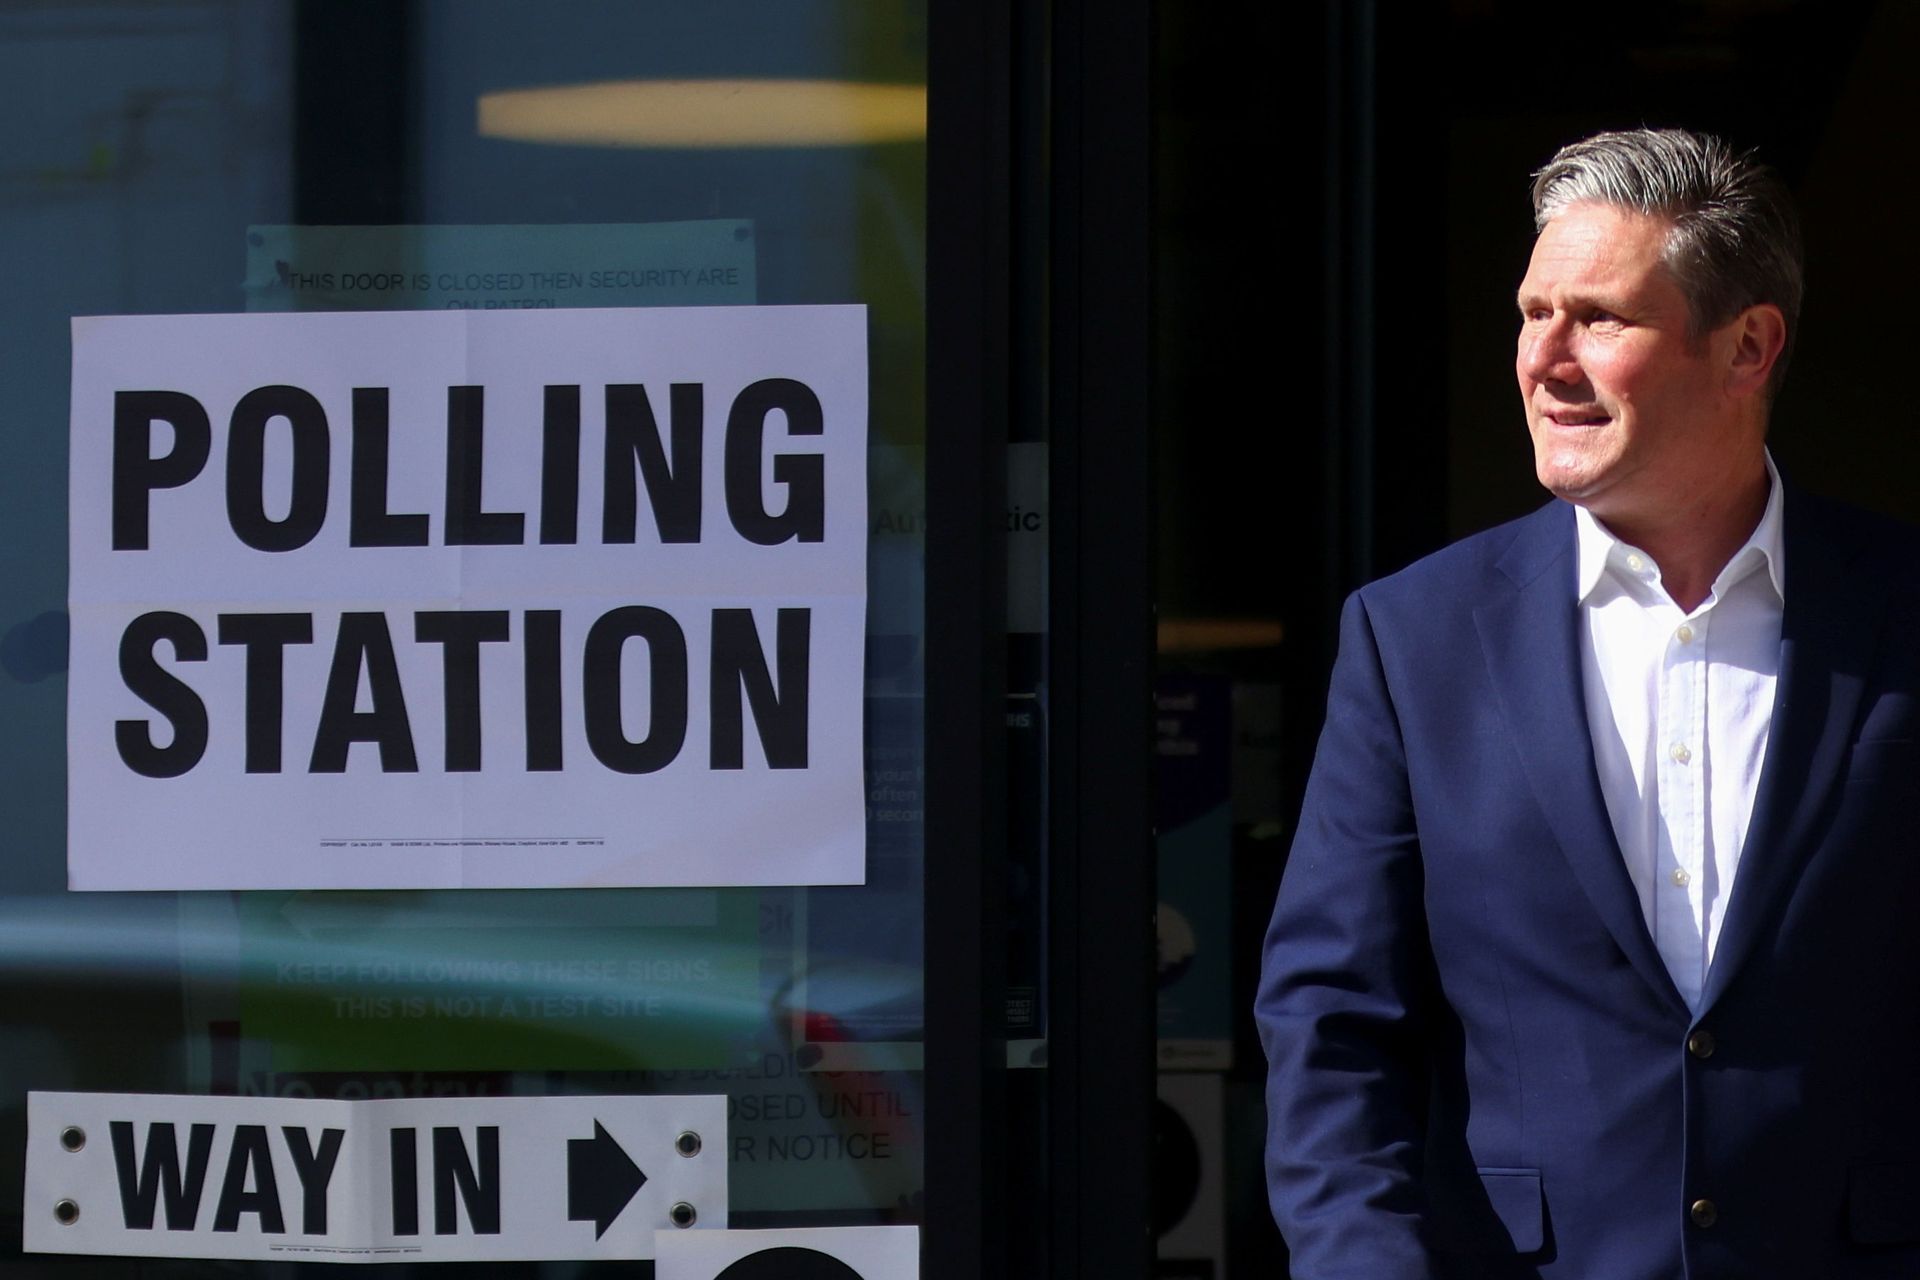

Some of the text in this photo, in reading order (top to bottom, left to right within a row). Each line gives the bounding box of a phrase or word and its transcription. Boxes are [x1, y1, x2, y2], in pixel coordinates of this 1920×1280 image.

[289, 267, 739, 292] THIS DOOR IS CLOSED THEN SECURITY ARE
[112, 378, 824, 552] POLLING
[115, 606, 811, 778] STATION
[276, 963, 346, 984] KEEP
[356, 960, 521, 983] FOLLOWING
[529, 959, 618, 982] THESE
[331, 995, 662, 1019] THIS IS NOT A TEST SITE
[818, 1091, 912, 1119] UNTIL
[767, 1132, 892, 1161] NOTICE
[109, 1121, 500, 1236] WAY IN
